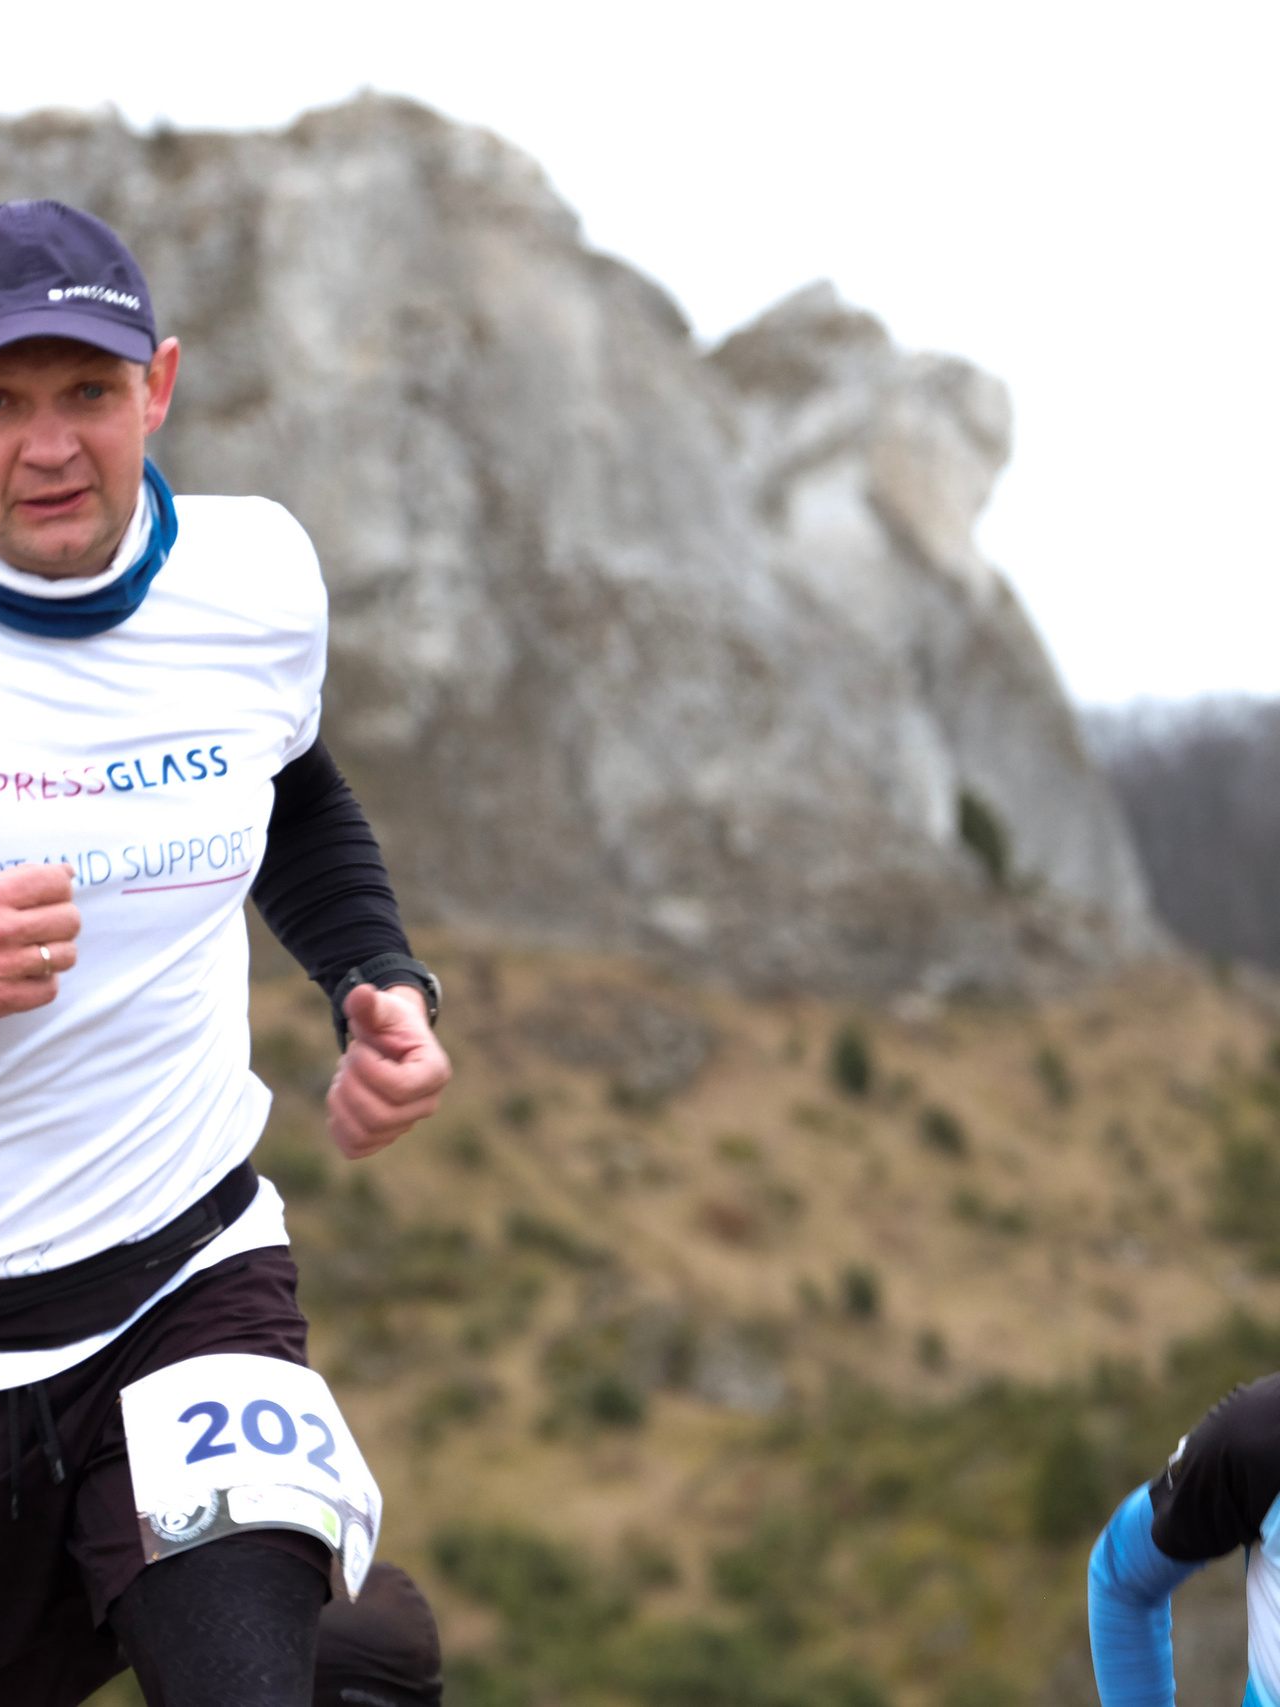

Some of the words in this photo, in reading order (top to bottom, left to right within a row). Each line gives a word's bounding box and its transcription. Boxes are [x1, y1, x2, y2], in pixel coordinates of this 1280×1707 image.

[41, 849, 113, 888] ND
[122, 826, 254, 883] SUPPORT
[177, 1399, 341, 1484] 202
